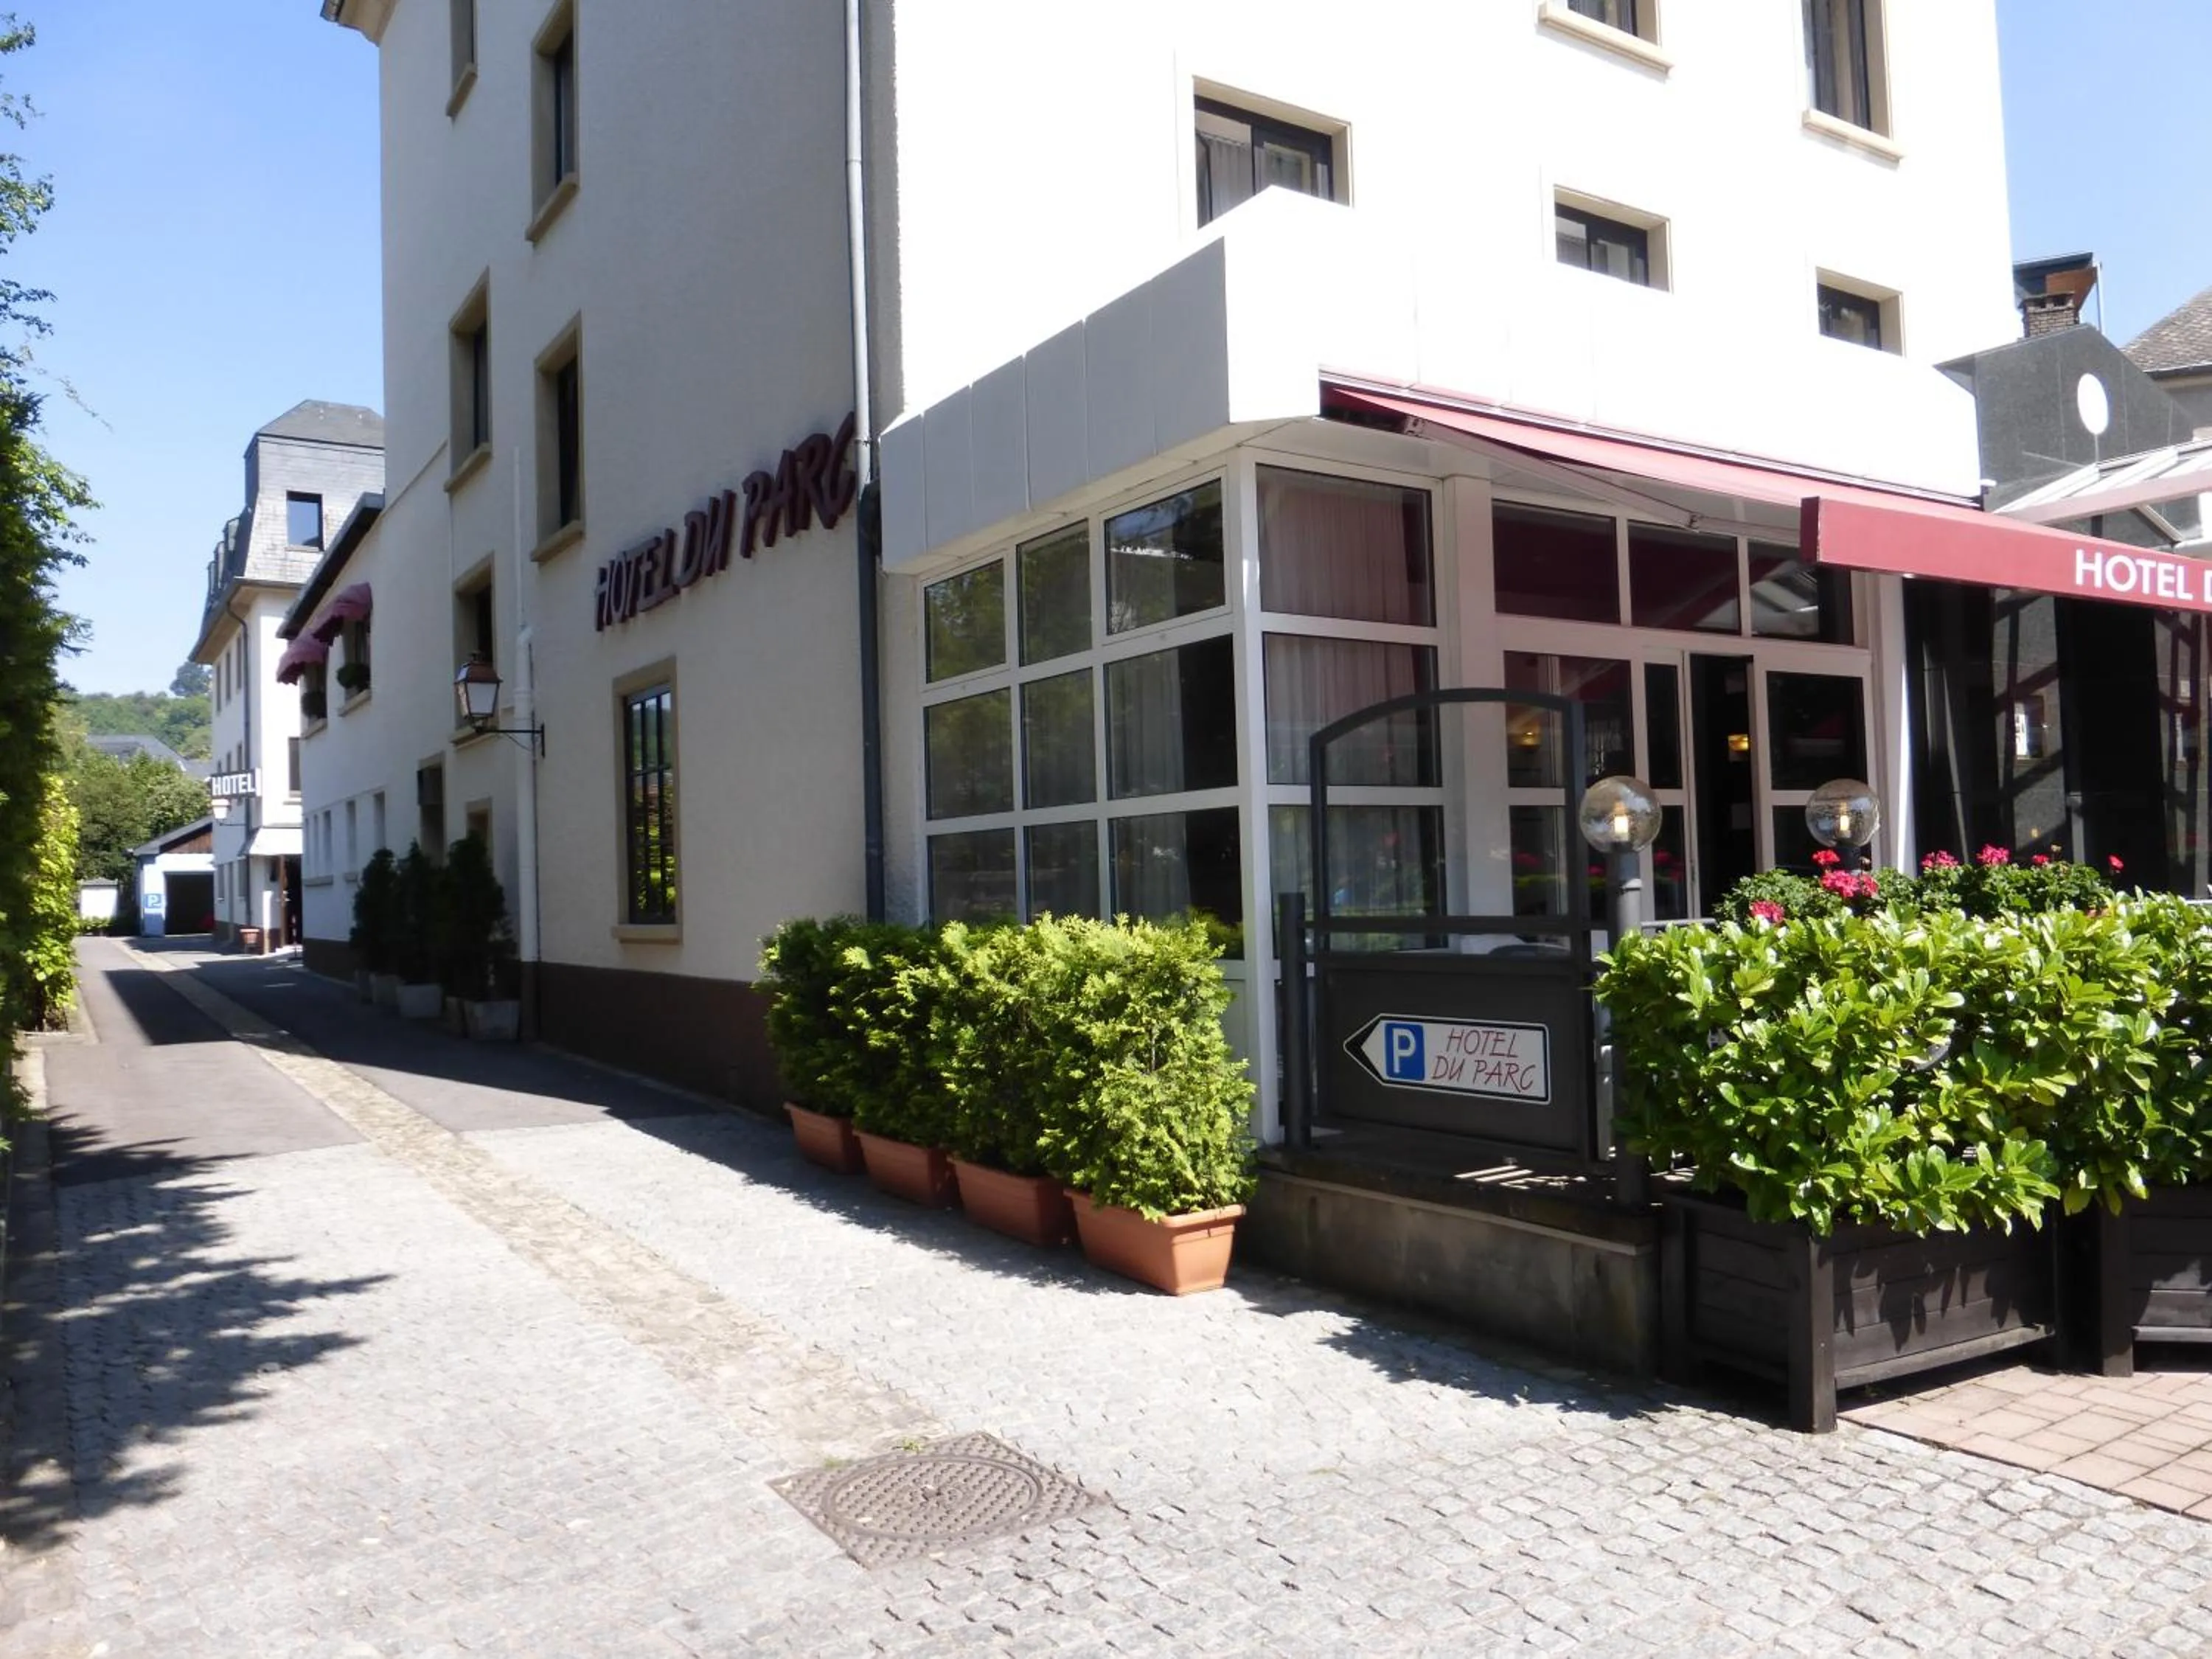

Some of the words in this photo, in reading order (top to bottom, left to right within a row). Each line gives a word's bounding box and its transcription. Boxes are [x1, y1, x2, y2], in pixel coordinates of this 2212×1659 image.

[595, 527, 680, 631] HOTEL
[679, 489, 736, 588] DU
[740, 411, 857, 558] PARC
[2076, 549, 2194, 601] HOTEL
[212, 773, 256, 796] HOTEL
[1391, 1028, 1416, 1074] P
[1445, 1028, 1519, 1059] HOTEL
[1430, 1055, 1464, 1082] DU
[1472, 1060, 1537, 1093] PARC
